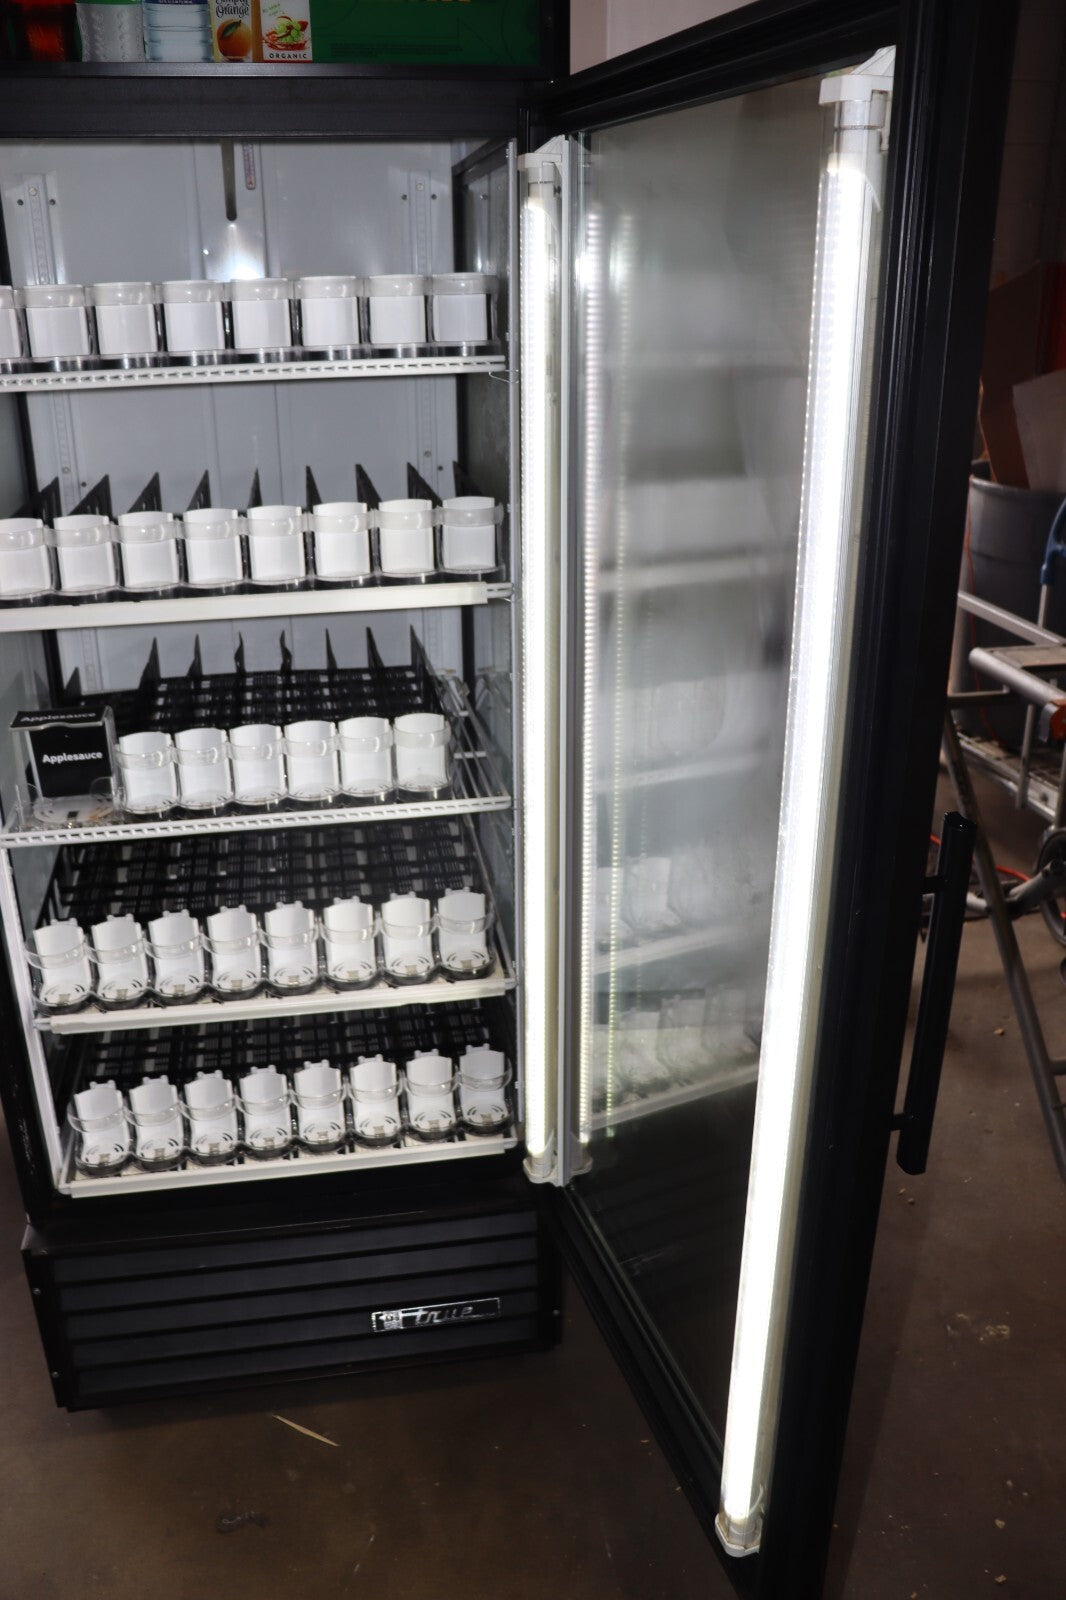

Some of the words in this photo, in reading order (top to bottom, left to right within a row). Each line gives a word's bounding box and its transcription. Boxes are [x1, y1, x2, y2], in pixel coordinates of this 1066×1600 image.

[215, 4, 249, 18] Orange
[20, 712, 97, 722] Applesauce
[42, 751, 103, 764] Applesauce
